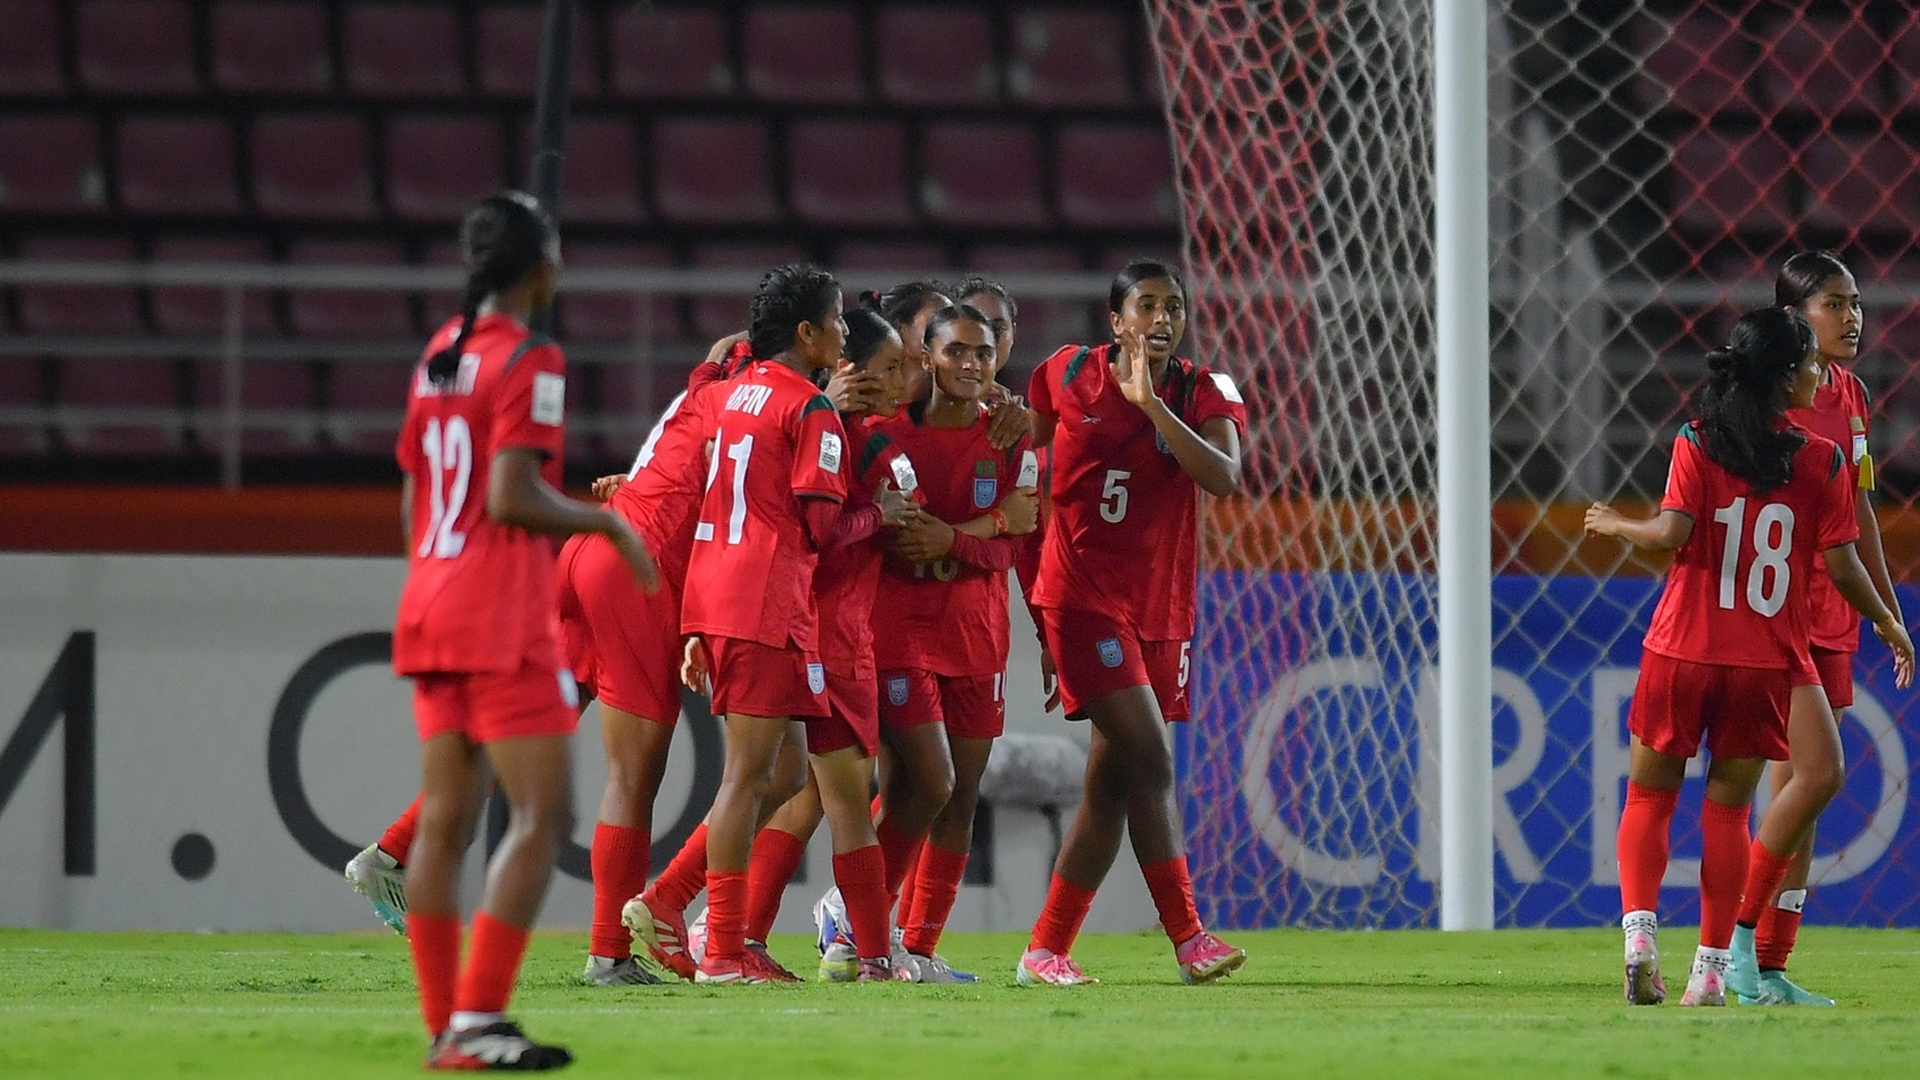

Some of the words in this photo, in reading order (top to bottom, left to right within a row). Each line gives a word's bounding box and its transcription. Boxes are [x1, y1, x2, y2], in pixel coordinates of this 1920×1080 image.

[421, 413, 473, 560] 12
[1099, 469, 1132, 523] 5
[1713, 496, 1795, 618] 18
[993, 671, 1006, 702] 1
[1177, 640, 1192, 688] 5
